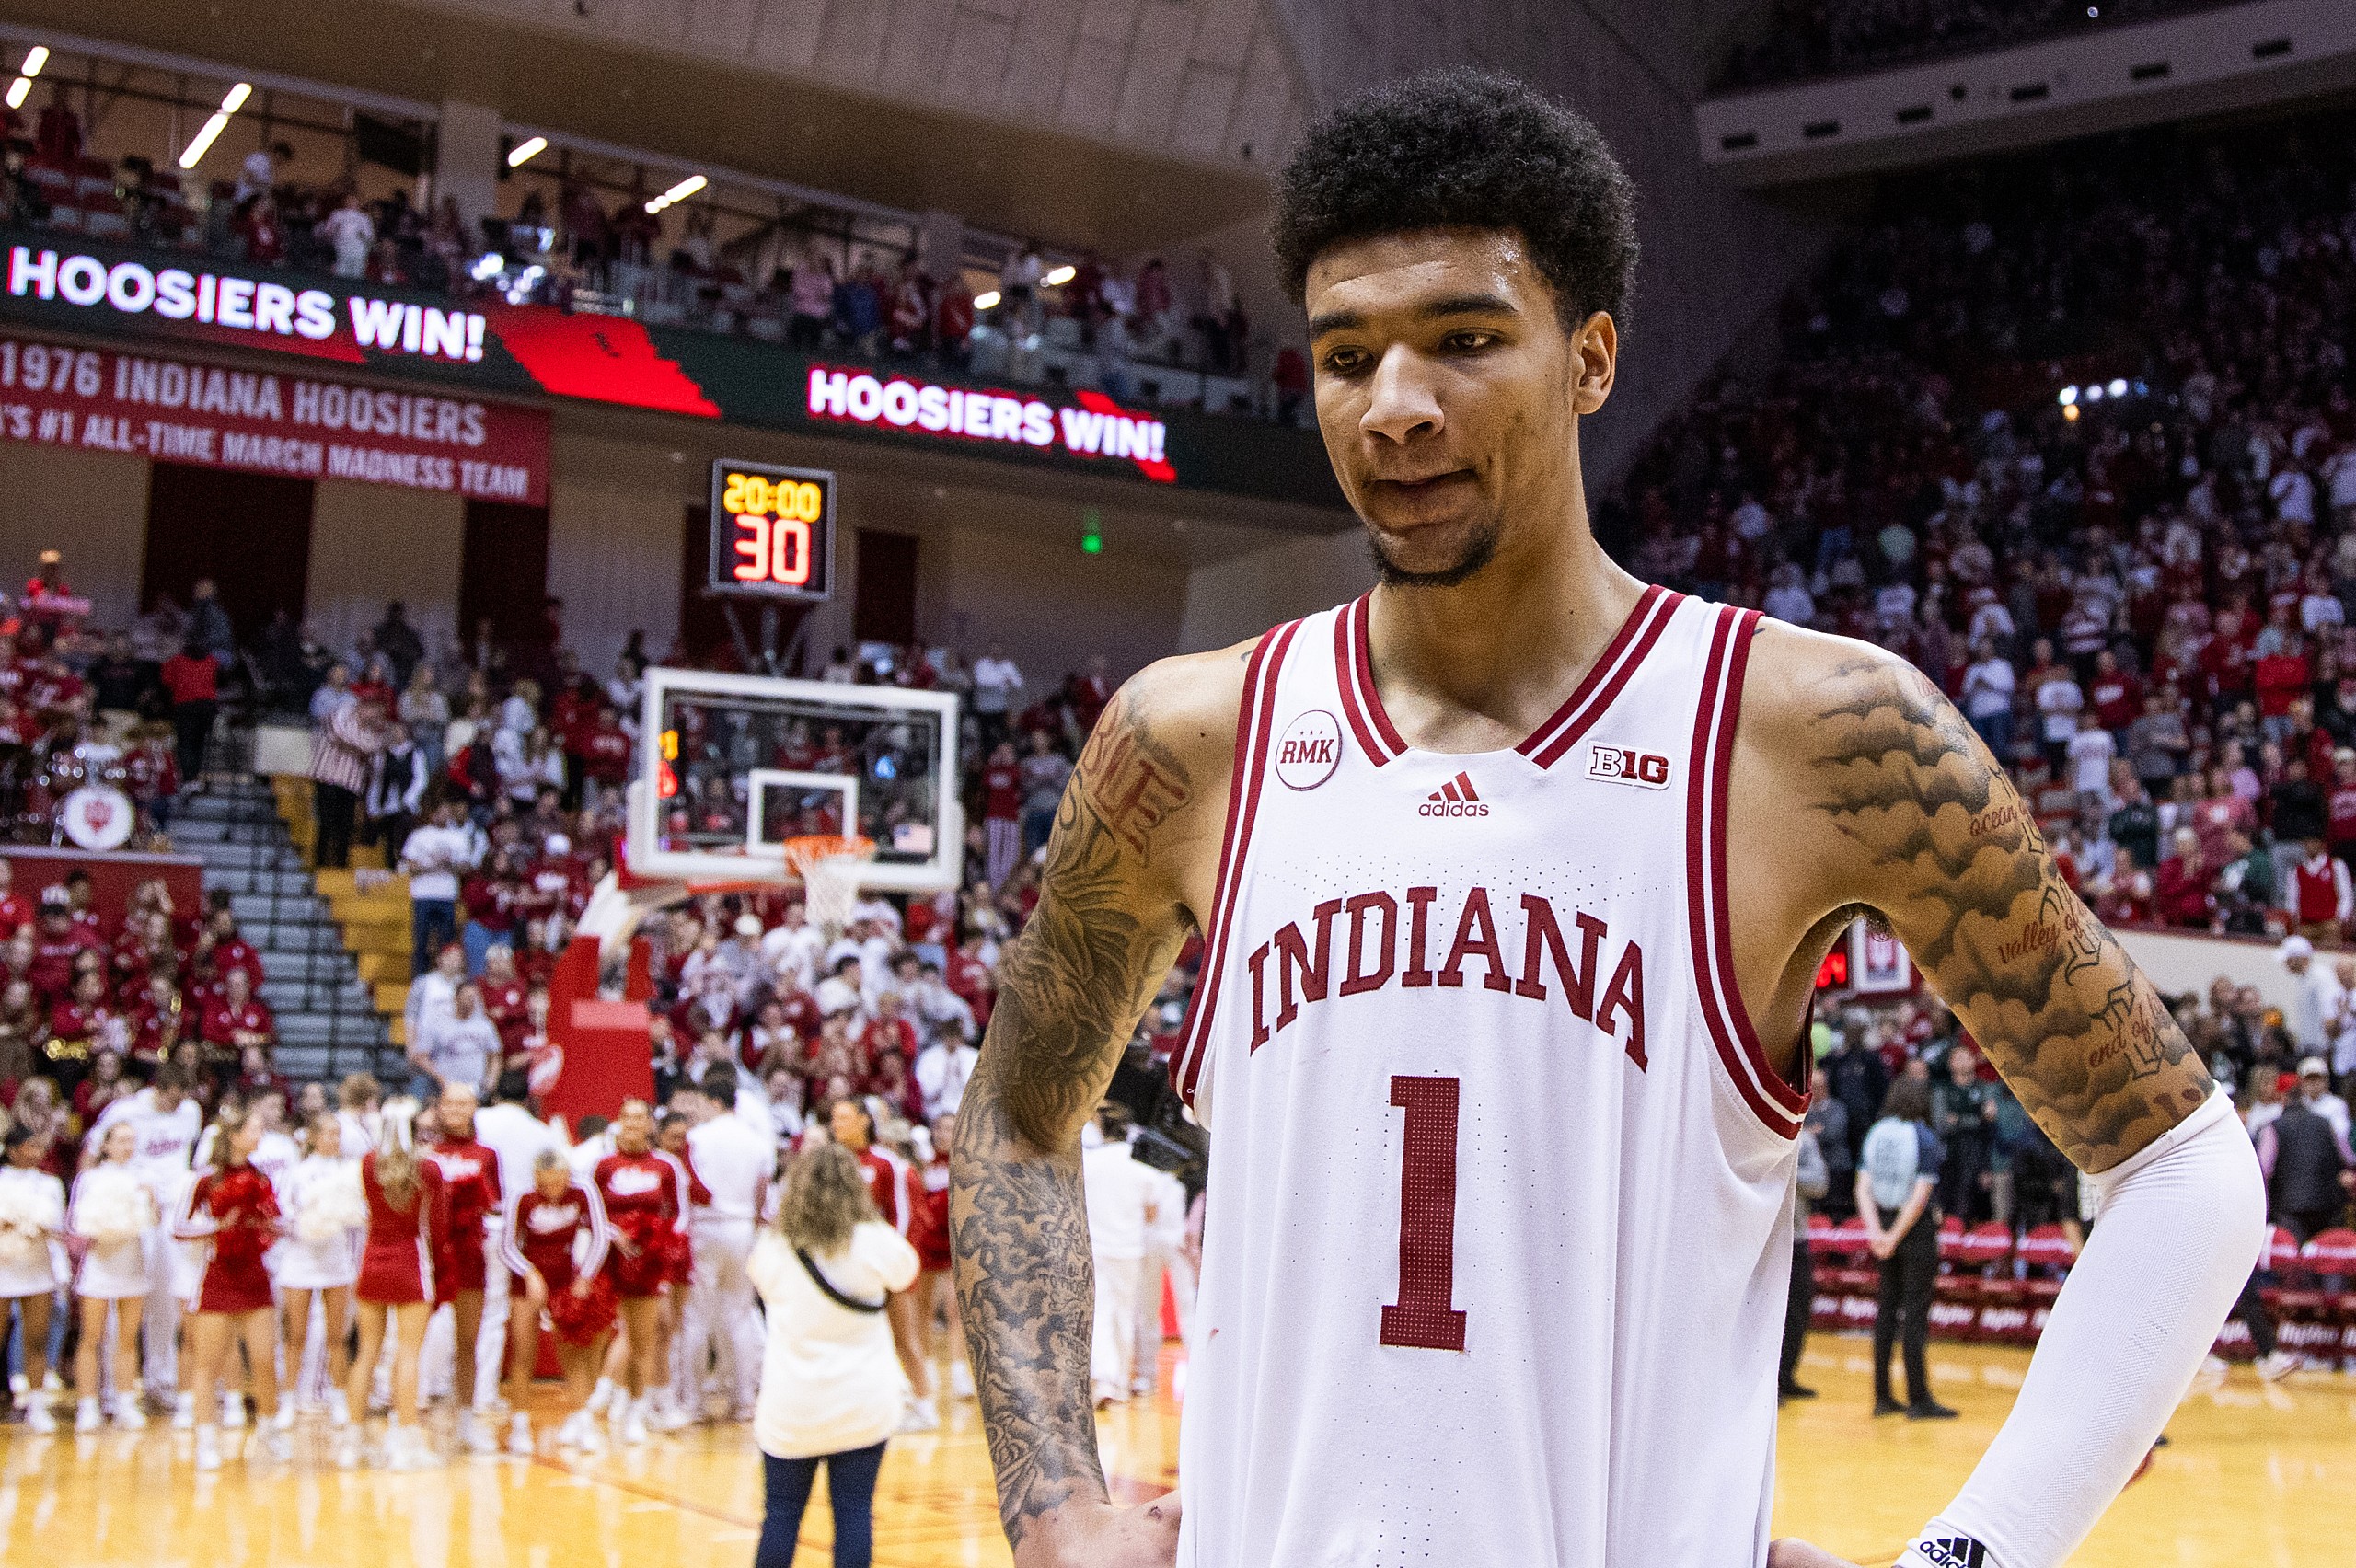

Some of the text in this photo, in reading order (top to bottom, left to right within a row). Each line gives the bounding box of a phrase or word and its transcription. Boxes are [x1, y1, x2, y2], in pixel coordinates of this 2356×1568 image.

[7, 245, 487, 362] HOOSIERS WIN!
[1, 341, 486, 446] 1976 INDIANA HOOSIERS
[809, 368, 1166, 463] HOOSIERS WIN!
[38, 409, 74, 444] #1
[83, 414, 214, 461] ALL-TIME
[222, 432, 322, 473] MARCH
[328, 444, 454, 490] MADNESS
[461, 460, 528, 498] TEAM
[723, 473, 822, 524] 20:00
[733, 513, 812, 586] 30
[1280, 739, 1334, 764] RMK
[1418, 800, 1490, 817] adidas
[1970, 806, 2018, 837] ocean
[1998, 921, 2060, 964] valley
[1248, 886, 1649, 1074] INDIANA
[2089, 1027, 2127, 1067] end
[1380, 1074, 1467, 1351] 1
